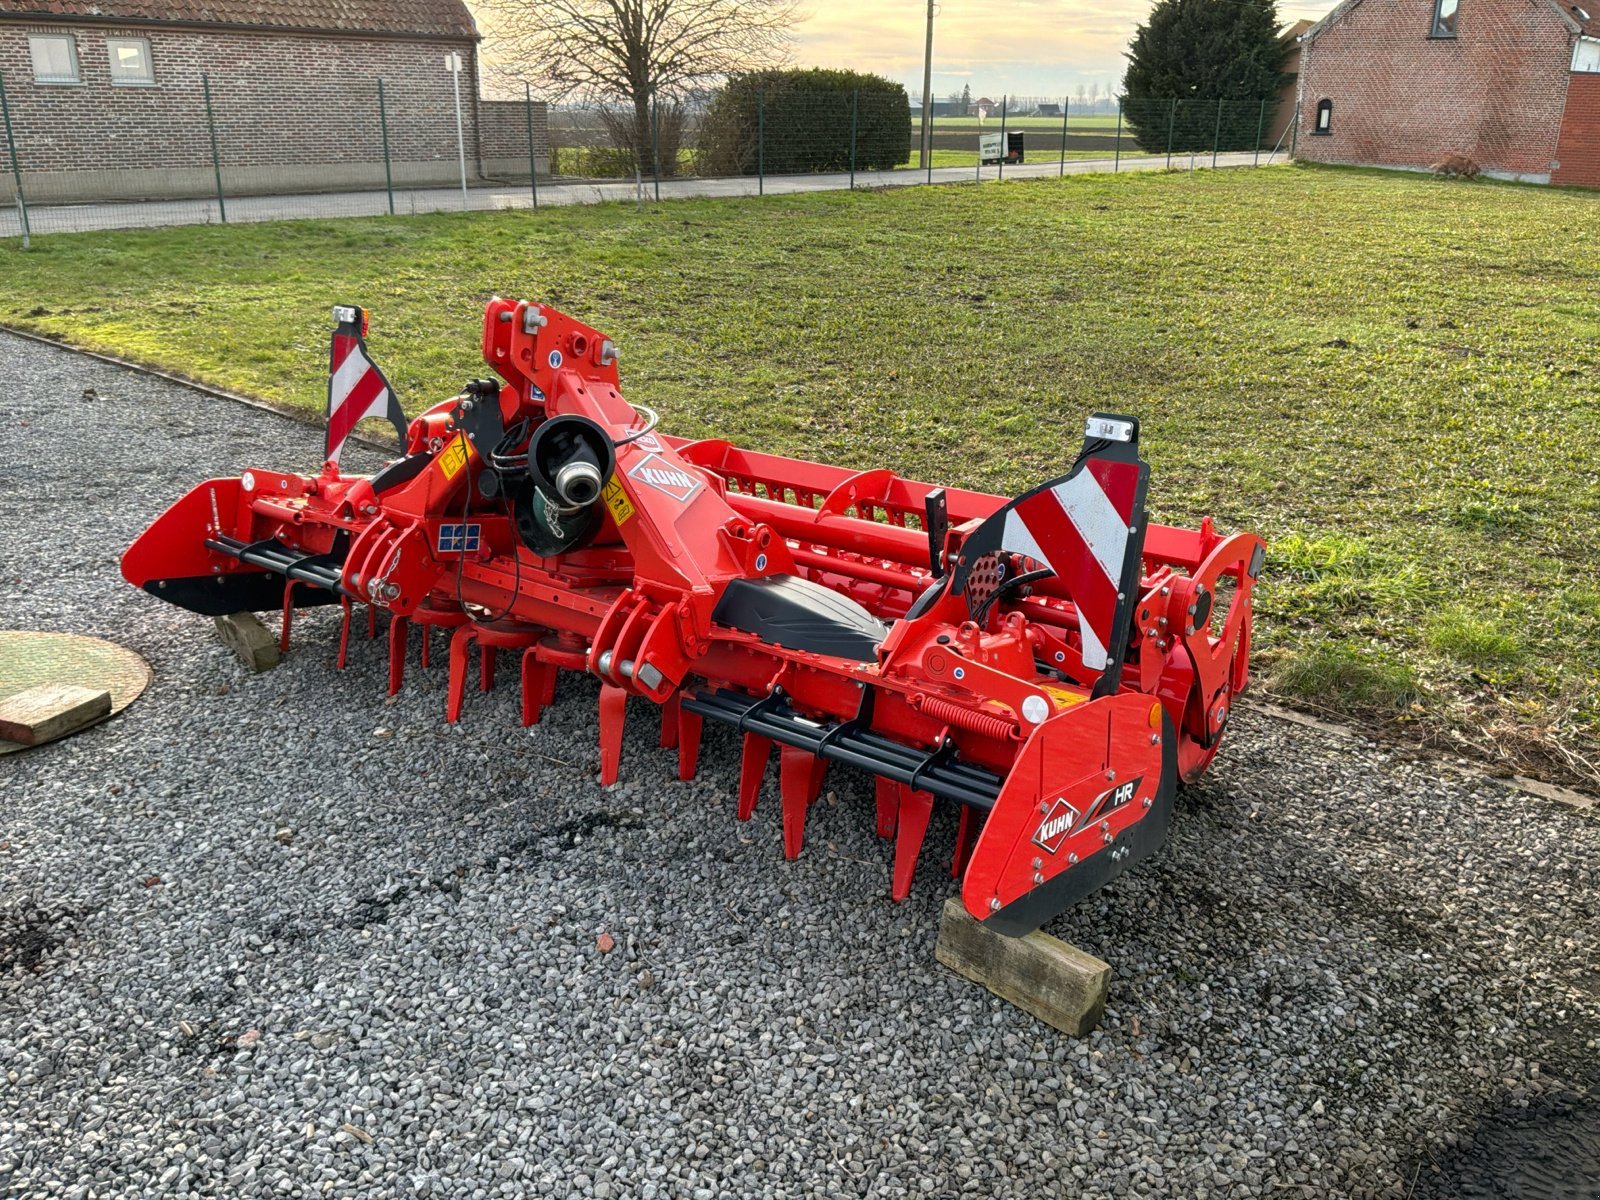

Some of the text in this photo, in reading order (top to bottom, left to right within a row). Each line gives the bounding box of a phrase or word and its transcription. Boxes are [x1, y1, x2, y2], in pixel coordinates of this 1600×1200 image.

[640, 467, 693, 488] KUHN
[1114, 782, 1133, 806] HR
[1040, 811, 1074, 842] KUHN
